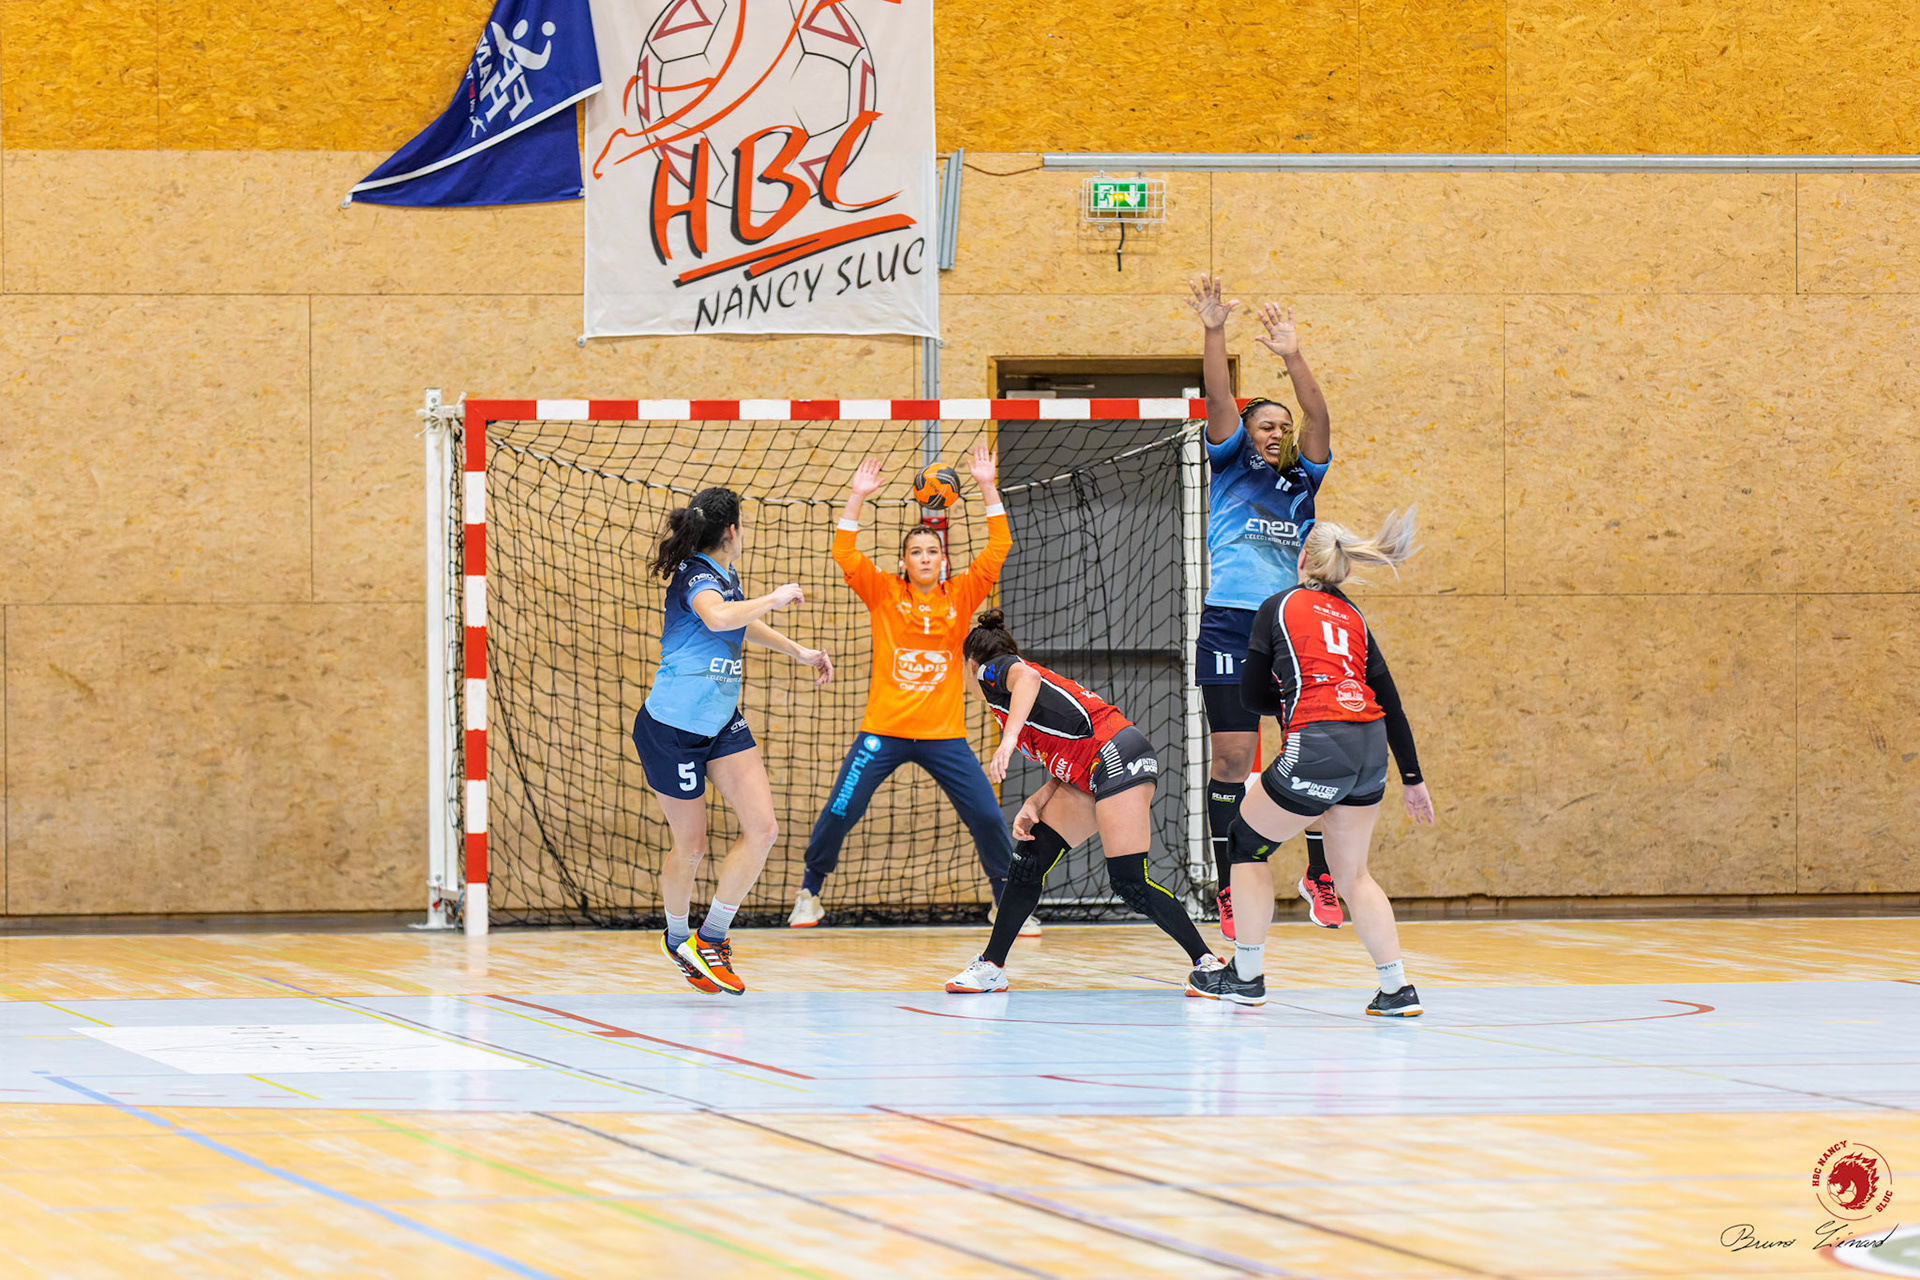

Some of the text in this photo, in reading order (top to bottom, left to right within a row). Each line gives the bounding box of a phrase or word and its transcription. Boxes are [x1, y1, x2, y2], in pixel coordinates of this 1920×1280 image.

[649, 110, 905, 266] HBC
[694, 236, 925, 333] NANCY SLUC
[1275, 475, 1292, 492] 11
[923, 616, 930, 635] 1
[898, 661, 947, 673] VIADIS
[1213, 651, 1234, 675] 11
[678, 761, 697, 791] 5
[830, 749, 875, 817] hummel
[1211, 792, 1237, 801] SELECT
[1306, 788, 1336, 800] SPORT
[1310, 782, 1339, 794] INTER
